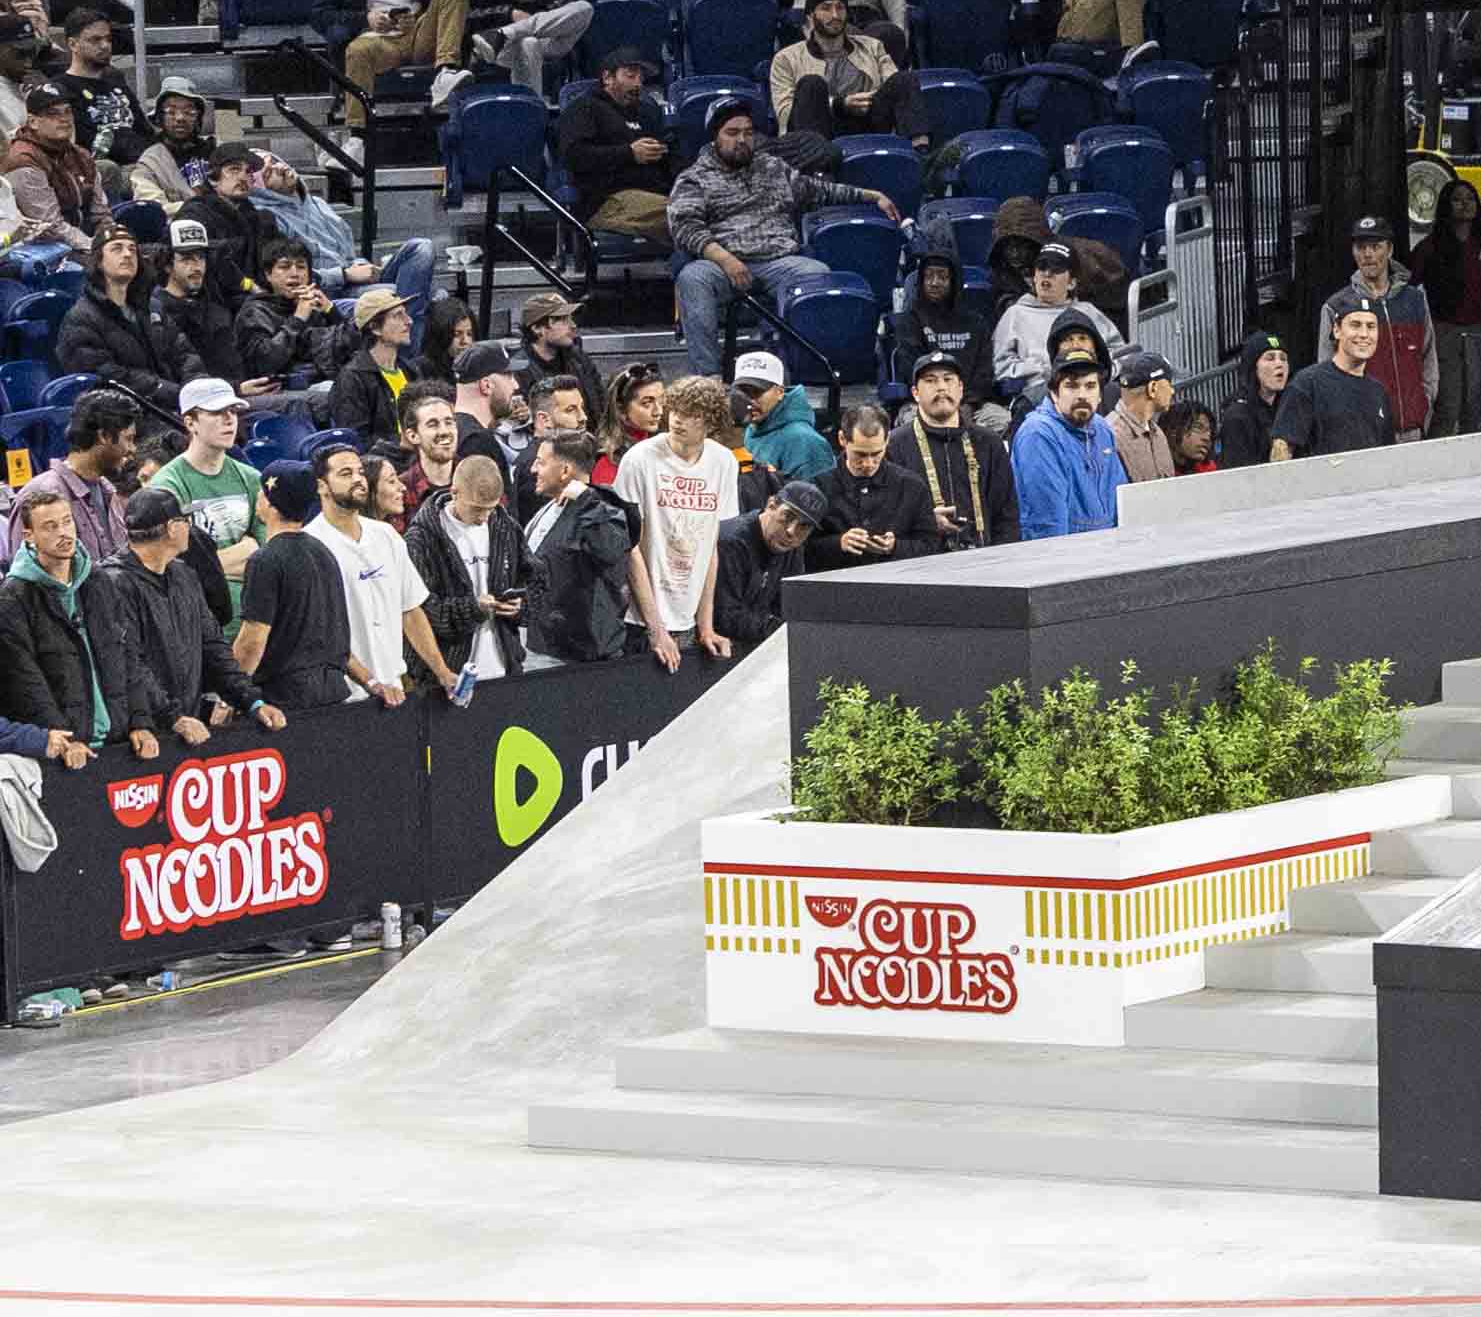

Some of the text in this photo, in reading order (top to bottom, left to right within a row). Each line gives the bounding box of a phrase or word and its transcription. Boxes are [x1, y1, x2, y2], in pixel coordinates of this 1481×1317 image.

[113, 783, 159, 811] NISSIN
[171, 756, 282, 843] CUP
[124, 821, 324, 932] NOODLES
[810, 900, 852, 918] NISSIN
[862, 903, 970, 955] CUP
[818, 954, 1013, 1009] NOODLES
